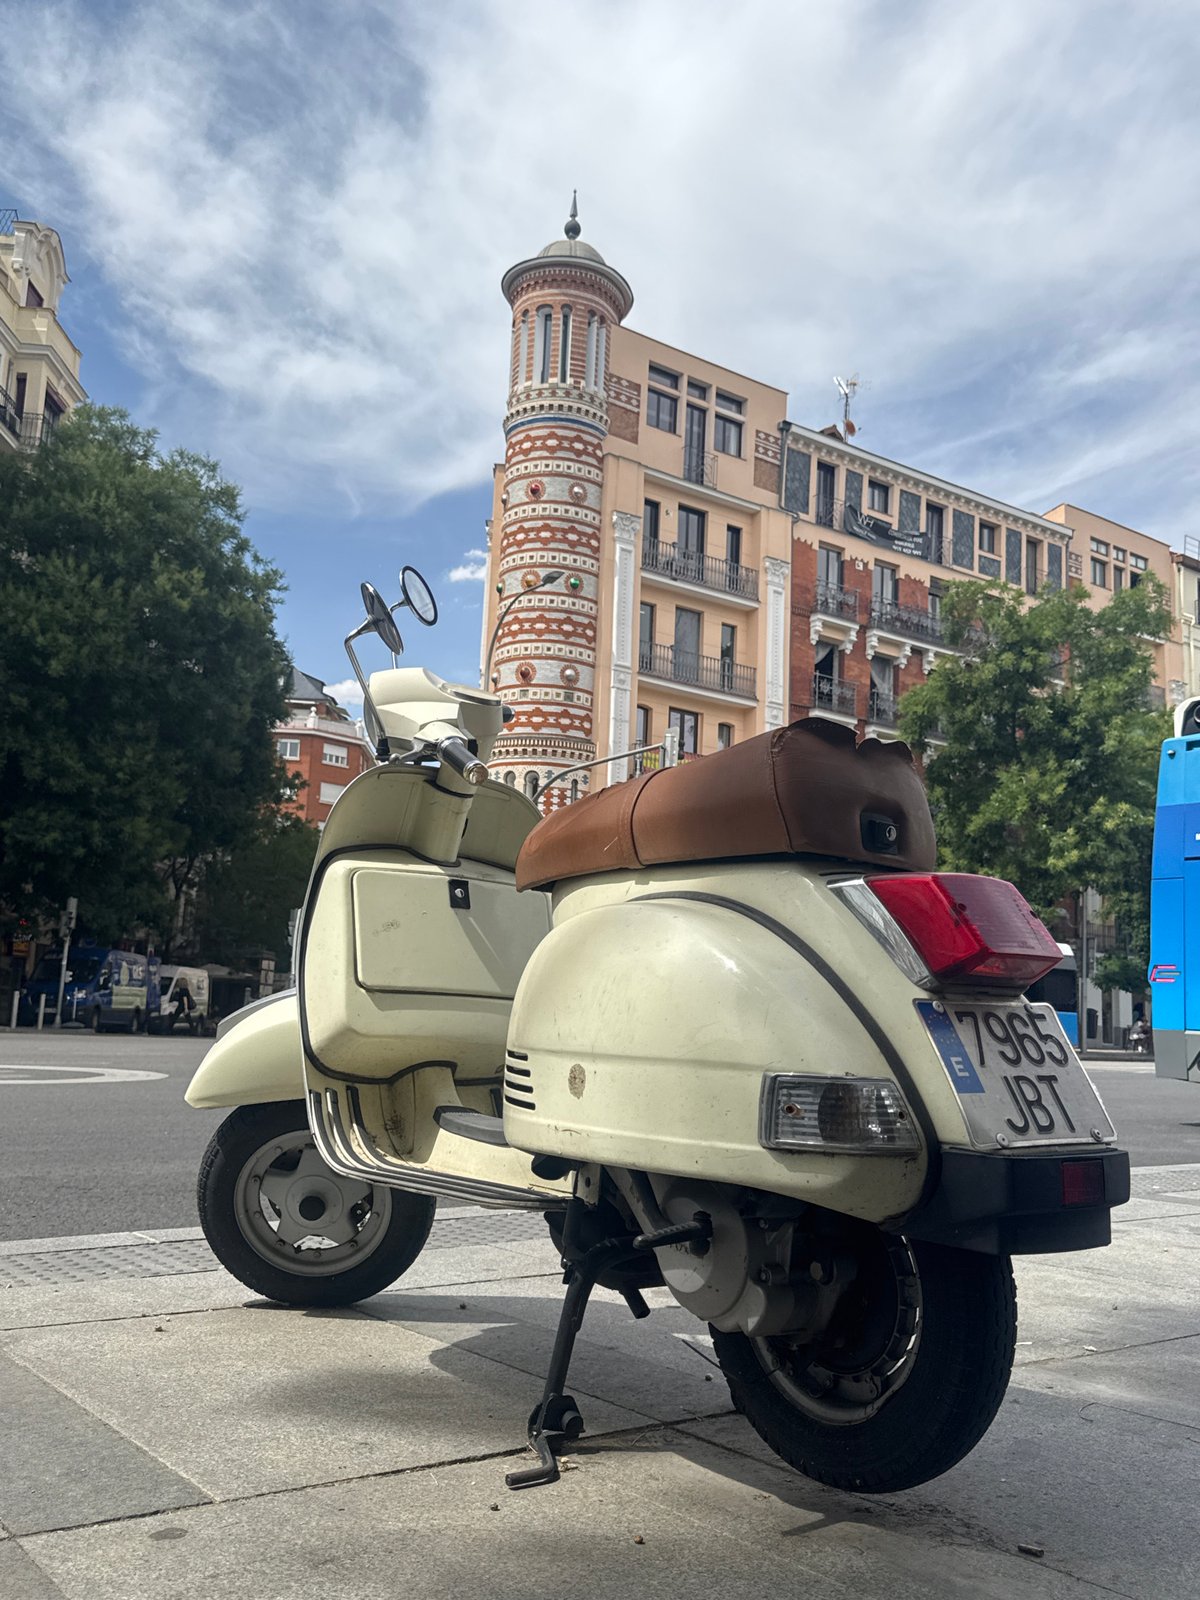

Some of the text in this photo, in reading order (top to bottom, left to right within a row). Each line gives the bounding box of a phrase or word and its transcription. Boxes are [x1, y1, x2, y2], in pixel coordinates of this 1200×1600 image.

[950, 1056, 970, 1077] E
[954, 1008, 1070, 1067] 7965
[1002, 1074, 1076, 1134] JBT
